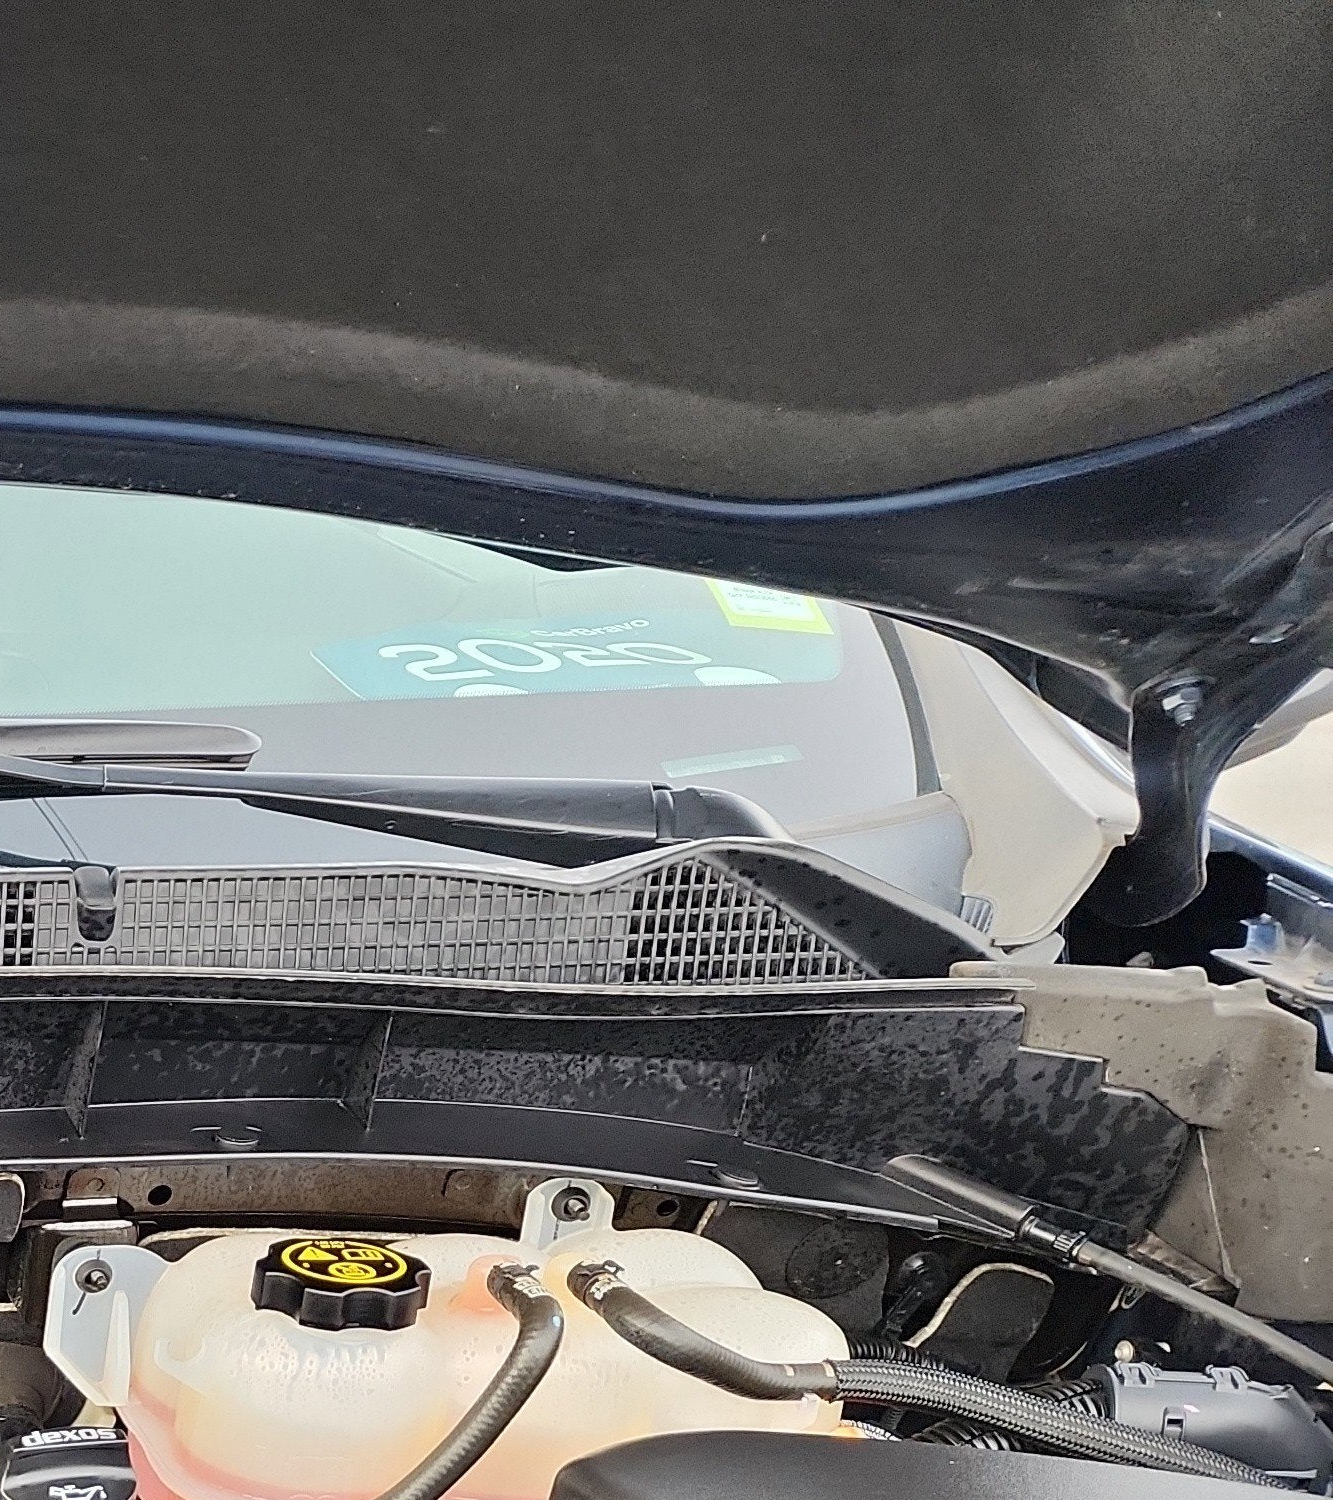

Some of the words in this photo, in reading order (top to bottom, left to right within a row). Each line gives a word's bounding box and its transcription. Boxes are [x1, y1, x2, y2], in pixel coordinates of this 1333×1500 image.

[531, 617, 651, 638] CarBravo
[378, 637, 713, 682] 2020
[21, 1428, 117, 1447] dexos
